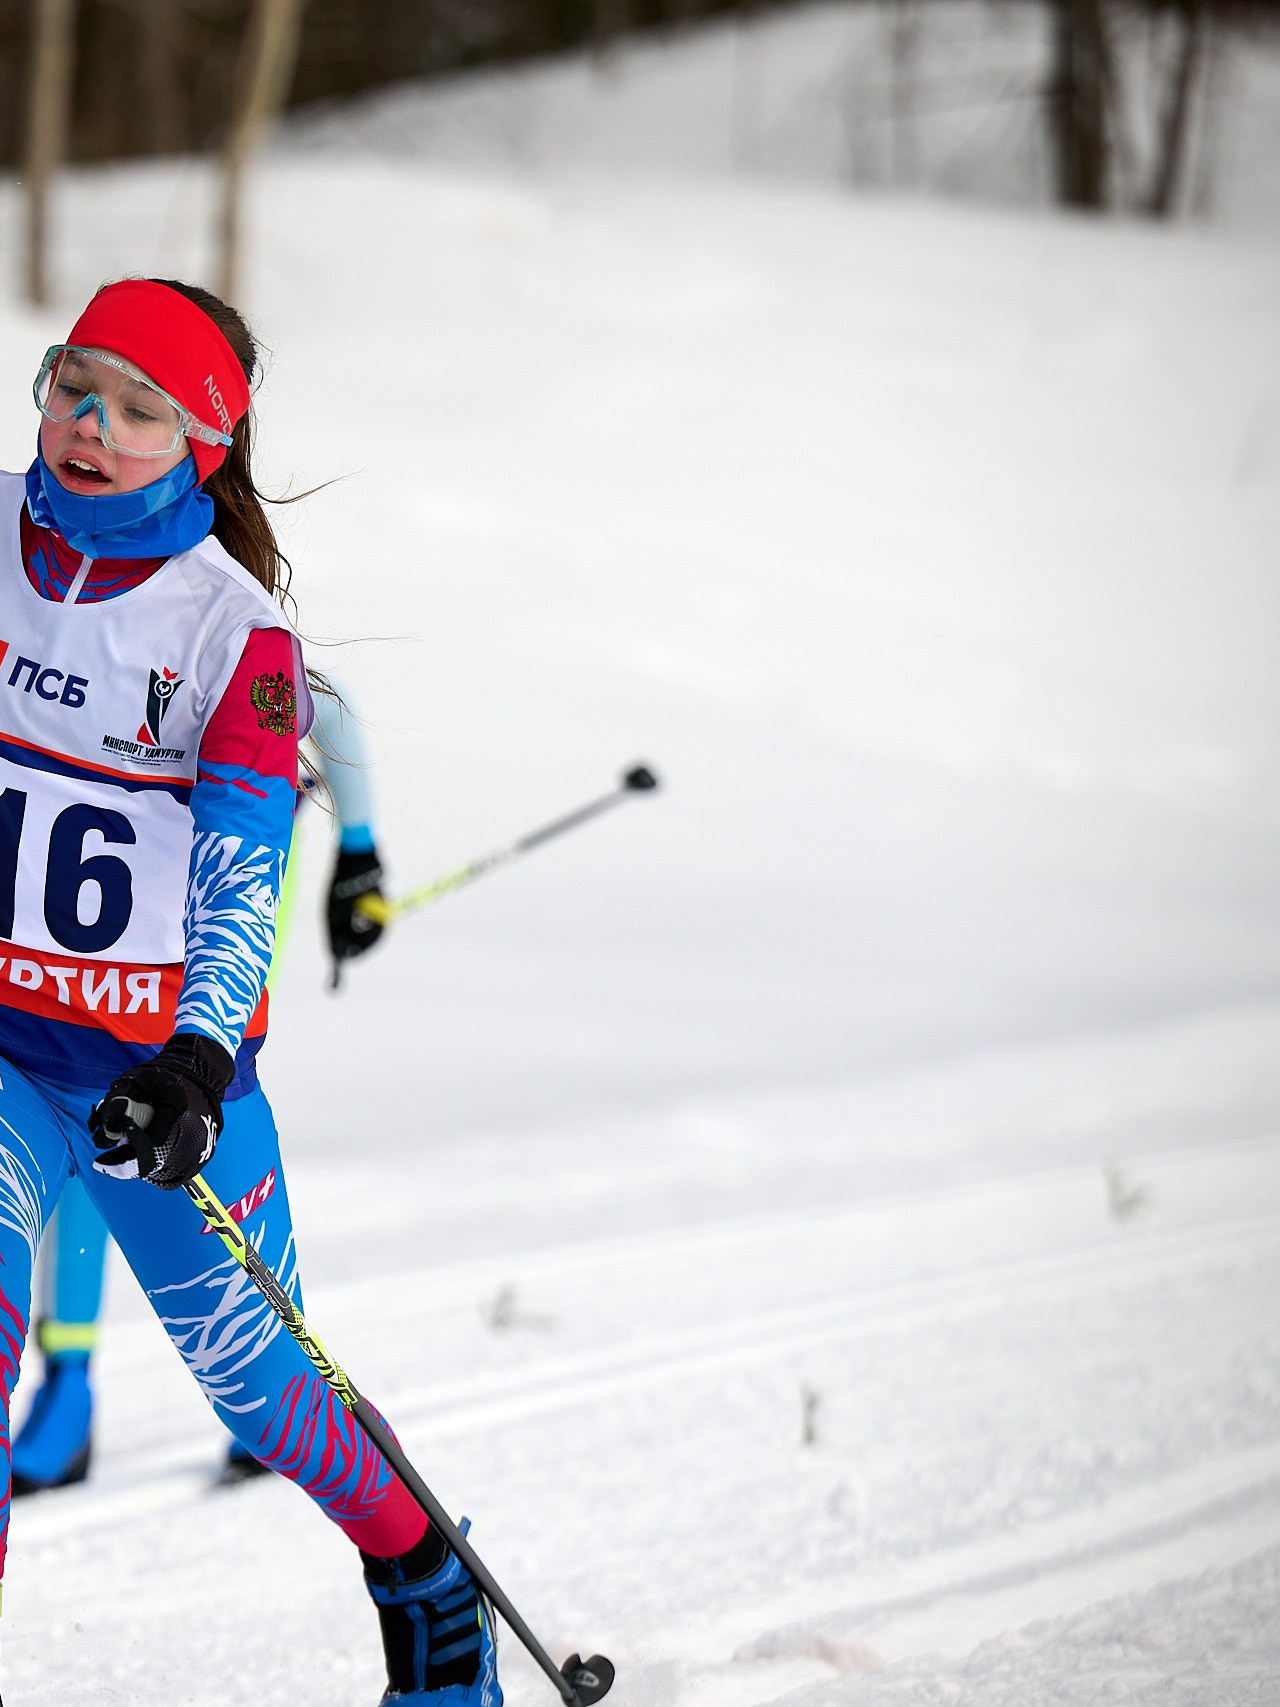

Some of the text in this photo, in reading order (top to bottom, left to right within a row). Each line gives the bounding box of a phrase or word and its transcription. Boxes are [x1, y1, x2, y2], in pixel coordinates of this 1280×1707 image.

[7, 655, 90, 709] ПСБ
[102, 734, 144, 757] МИНСПОРТ
[250, 1273, 285, 1318] COMPOSITE
